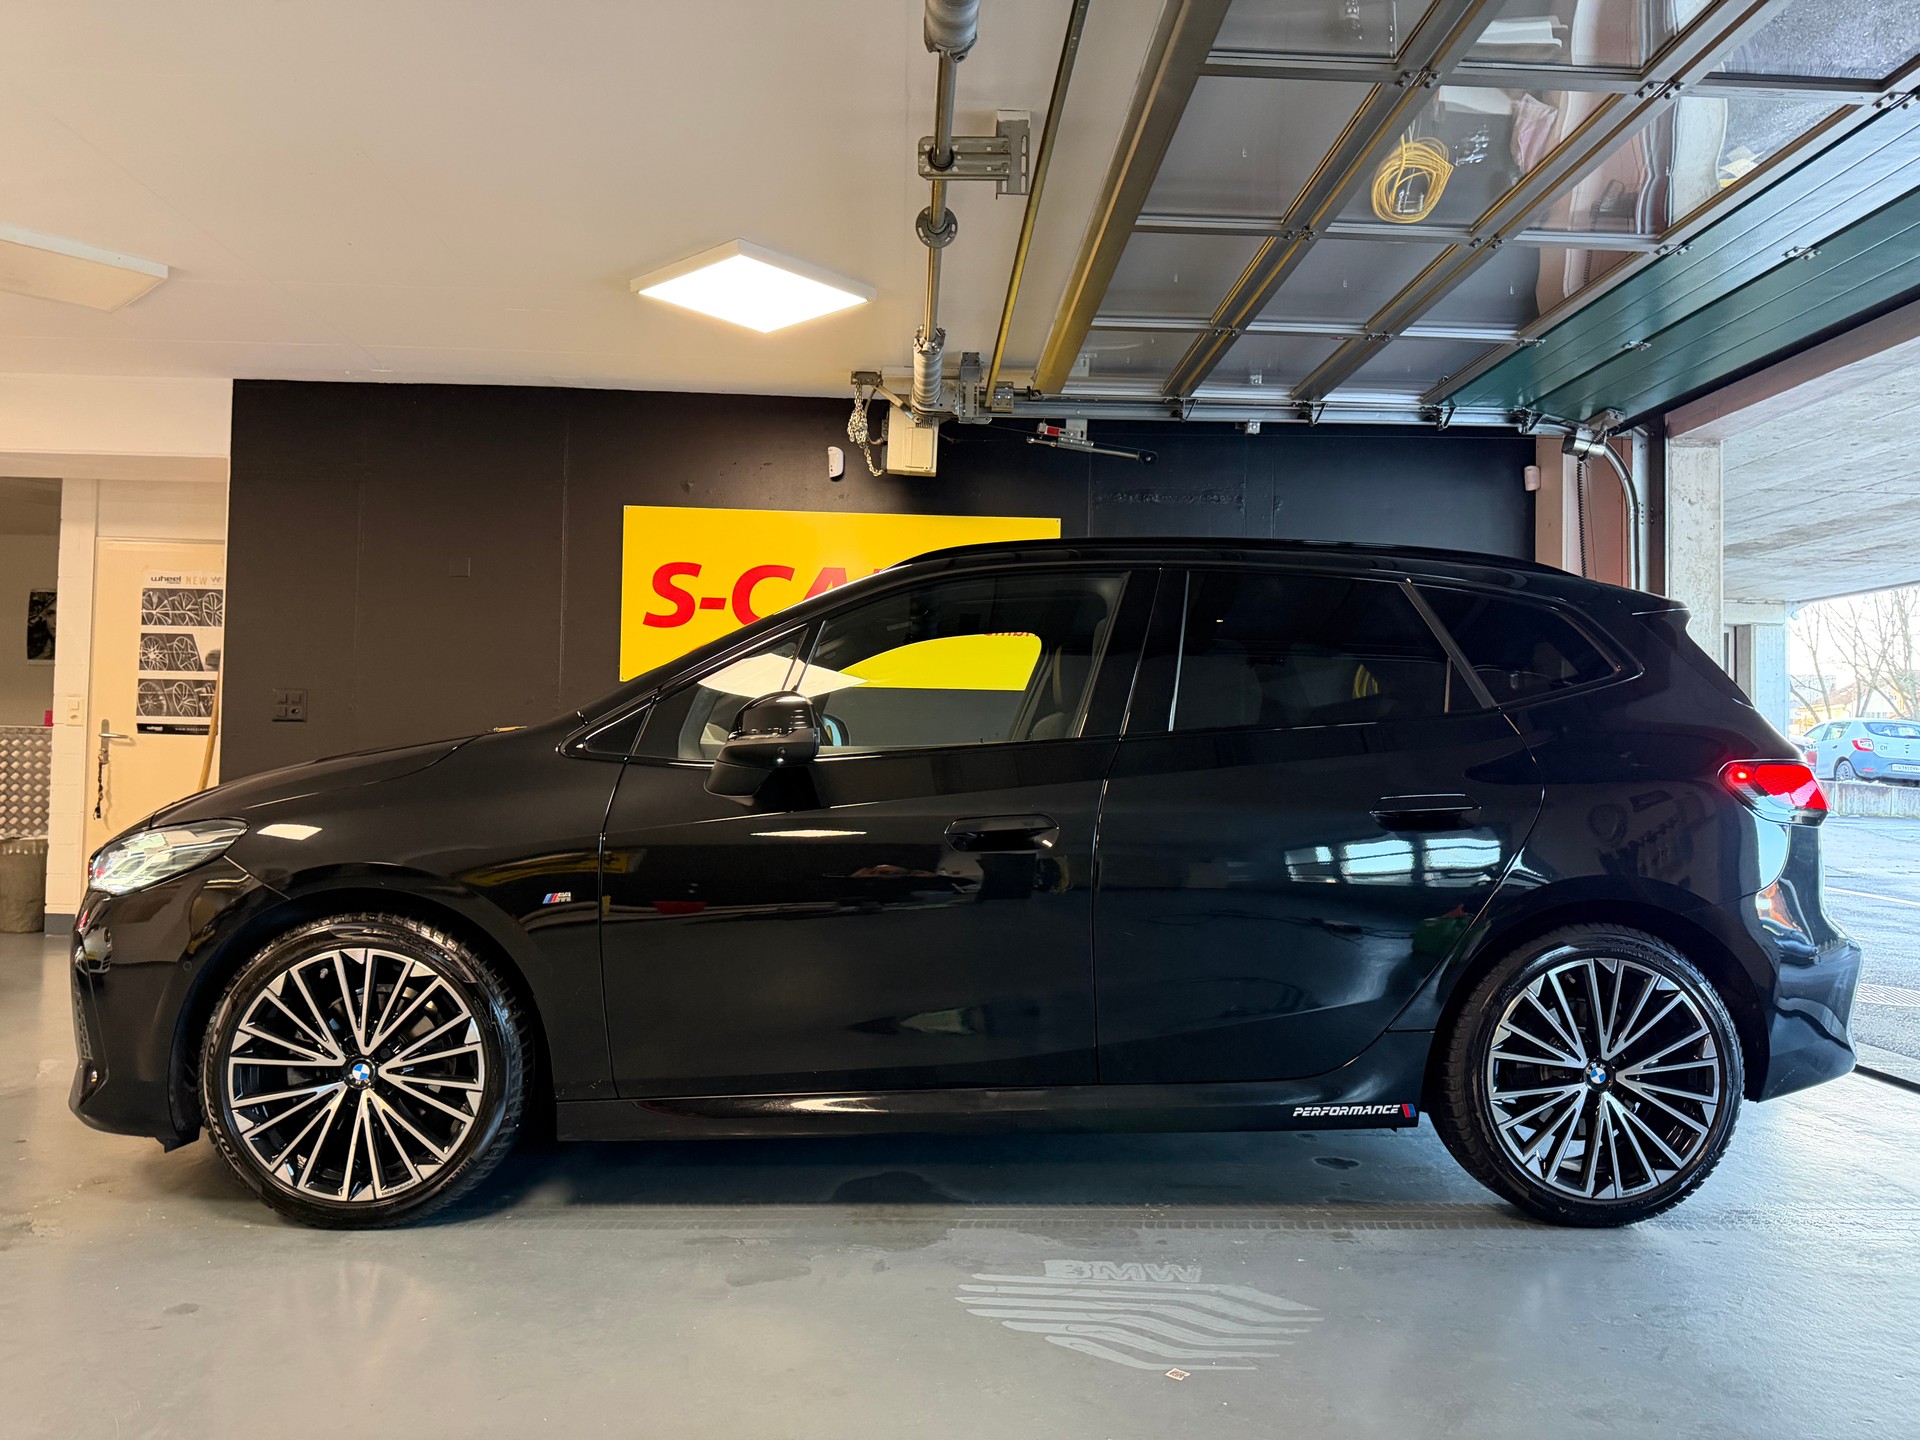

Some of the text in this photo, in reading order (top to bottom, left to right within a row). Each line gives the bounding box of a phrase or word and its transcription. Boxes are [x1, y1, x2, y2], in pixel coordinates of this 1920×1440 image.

[185, 575, 208, 585] NEW
[642, 561, 885, 628] S-CA
[1292, 1104, 1401, 1117] PERFORMANCE
[1043, 1259, 1201, 1282] BMW
